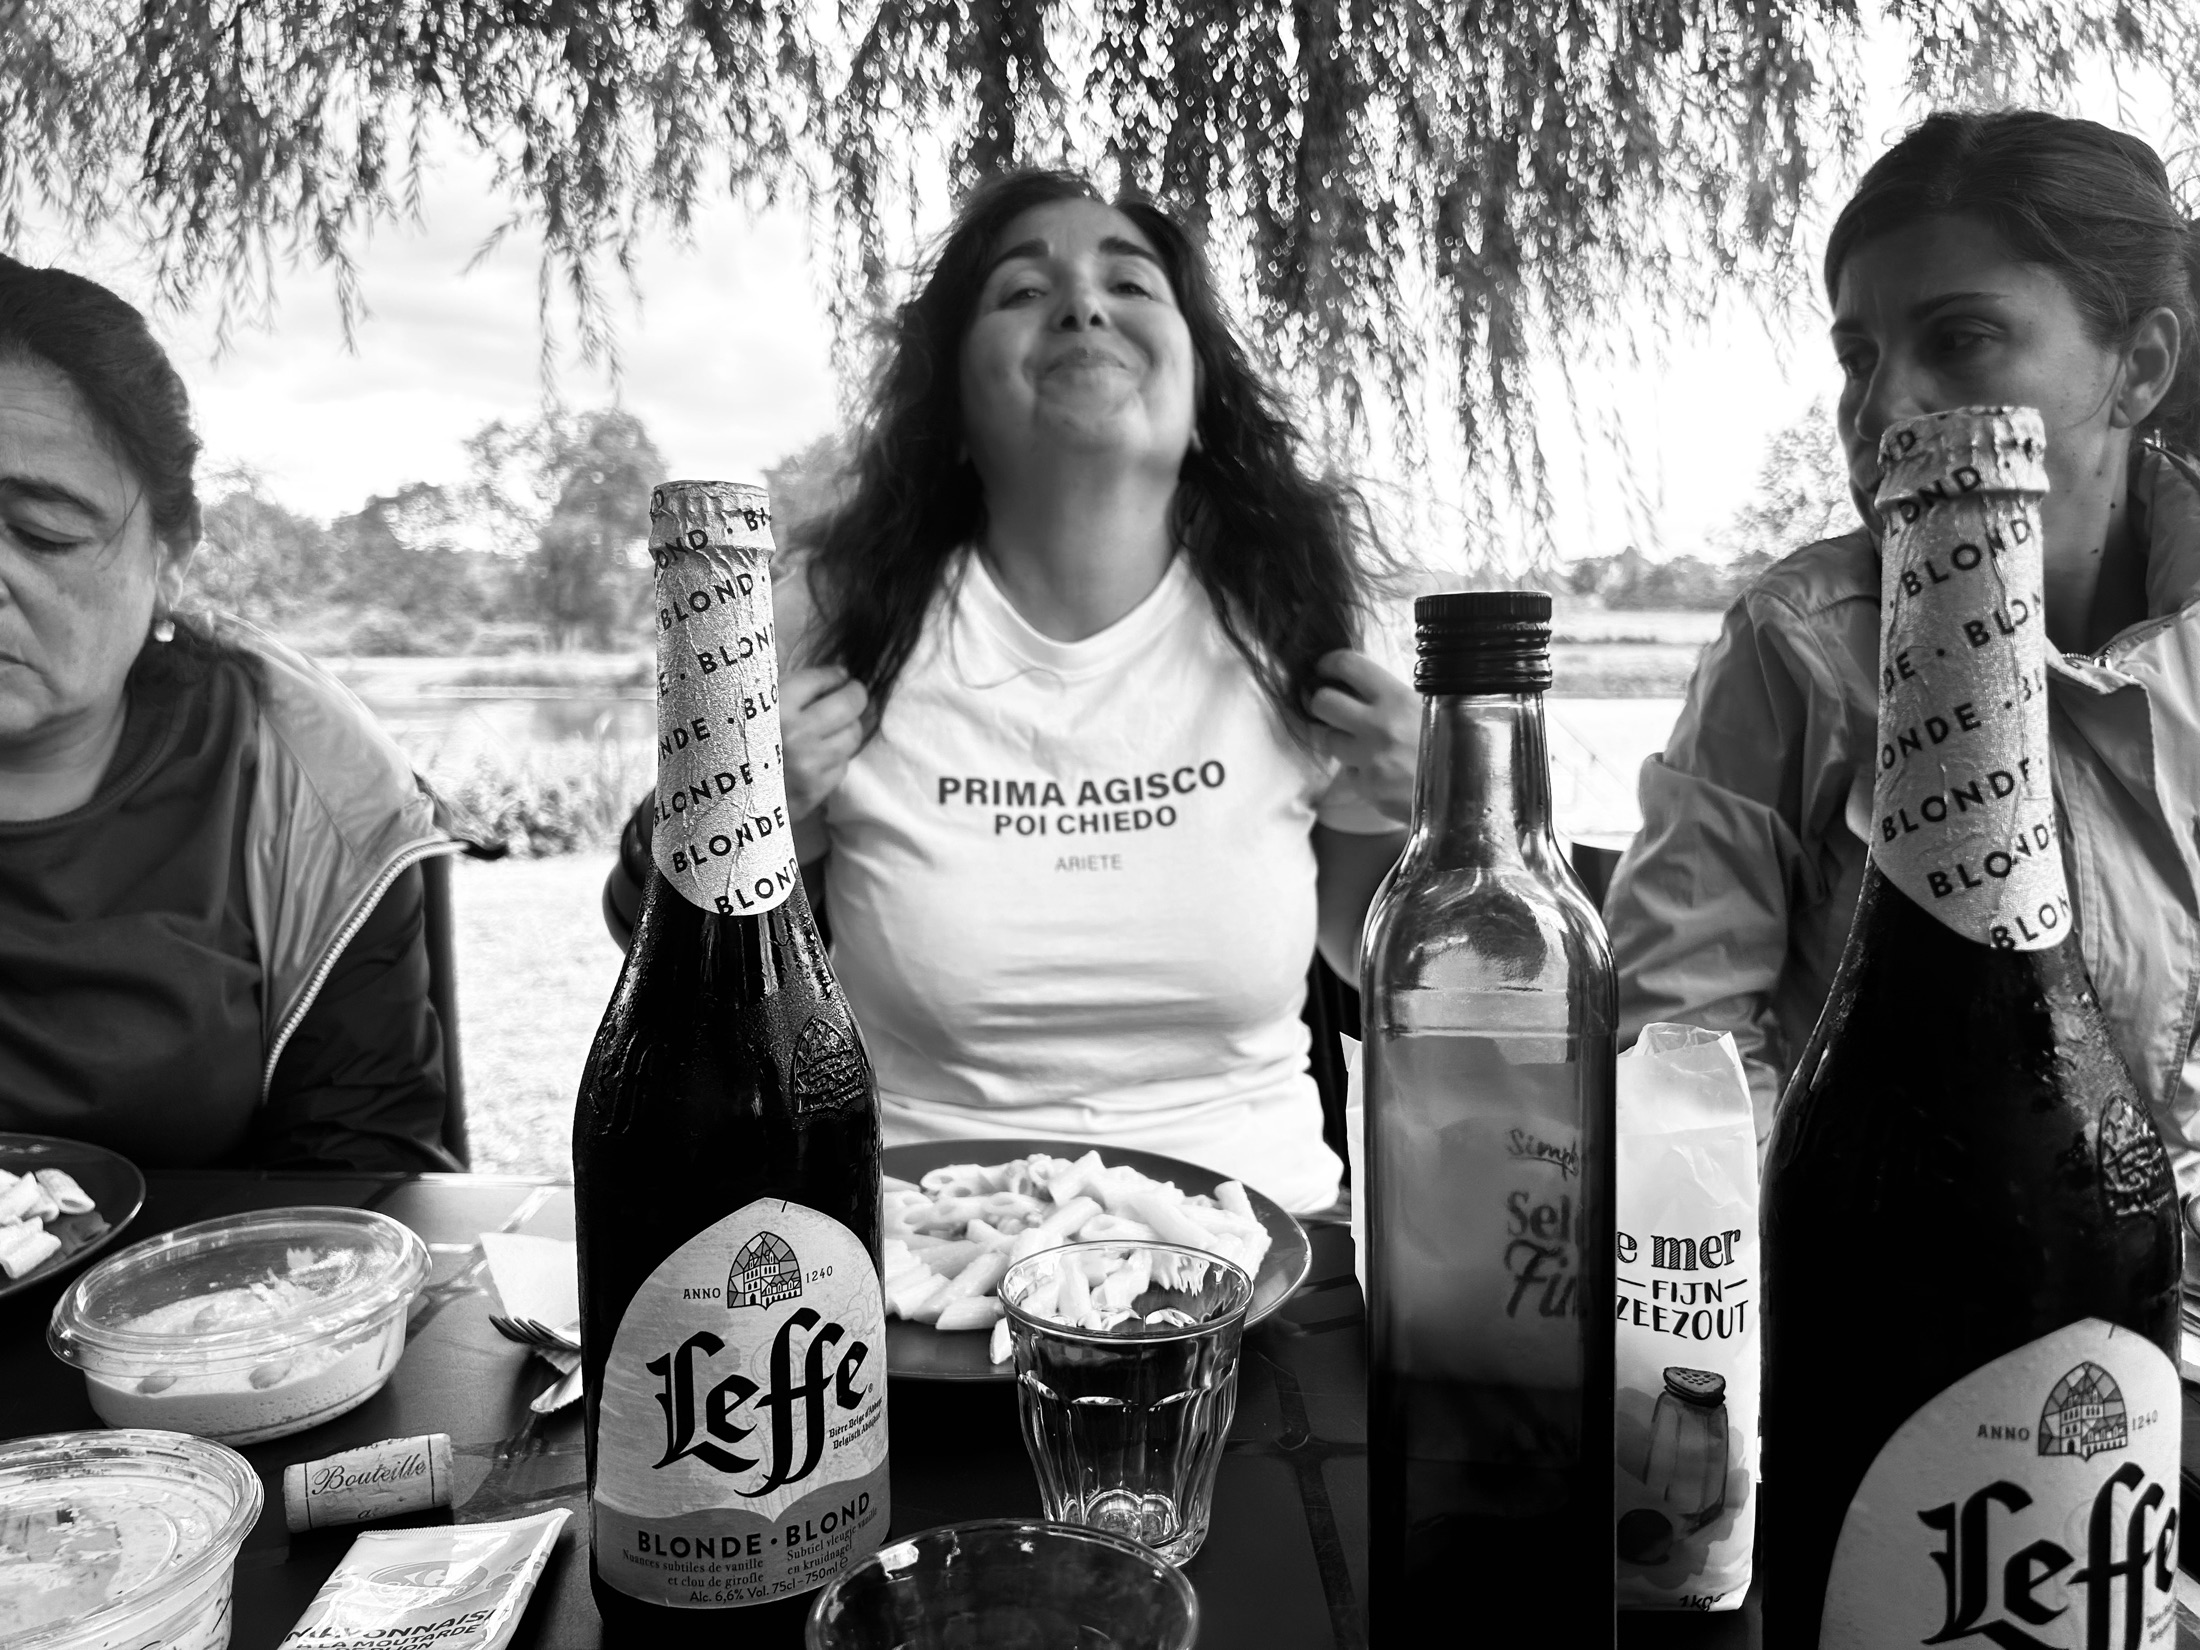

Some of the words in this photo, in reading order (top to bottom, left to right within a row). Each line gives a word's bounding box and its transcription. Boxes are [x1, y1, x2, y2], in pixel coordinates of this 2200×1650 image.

[661, 573, 754, 631] BLOND
[938, 777, 1066, 807] PRIMA
[1077, 760, 1226, 807] AGISCO
[995, 814, 1046, 836] POI
[1057, 805, 1178, 835] CHIEDO
[672, 806, 785, 873] BLONDE
[1054, 854, 1124, 872] ARIETE
[1651, 1228, 1741, 1271] mer
[683, 1287, 721, 1300] ANNO
[805, 1266, 833, 1284] 1240
[1652, 1278, 1723, 1305] FIJN
[646, 1307, 869, 1498] Leffe
[1976, 1423, 2031, 1442] ANNO
[2131, 1409, 2159, 1431] 1240
[311, 1453, 427, 1496] Bouteille
[638, 1530, 762, 1559] BLONDE
[786, 1491, 870, 1548] BLOND
[622, 1548, 660, 1569] Nuances
[663, 1559, 705, 1573] subtiles
[708, 1561, 722, 1573] de
[725, 1558, 764, 1572] vanille
[787, 1540, 824, 1562] Subtiel
[787, 1567, 801, 1575] en
[803, 1541, 853, 1571] kruidnagel
[667, 1576, 678, 1586] et
[681, 1575, 705, 1588] clou
[708, 1576, 722, 1587] de
[725, 1572, 764, 1590] girofle
[690, 1591, 712, 1603] Alc.
[715, 1588, 744, 1605] 6,6%
[747, 1585, 769, 1598] Vol.
[353, 1623, 482, 1648] MOUTARDE
